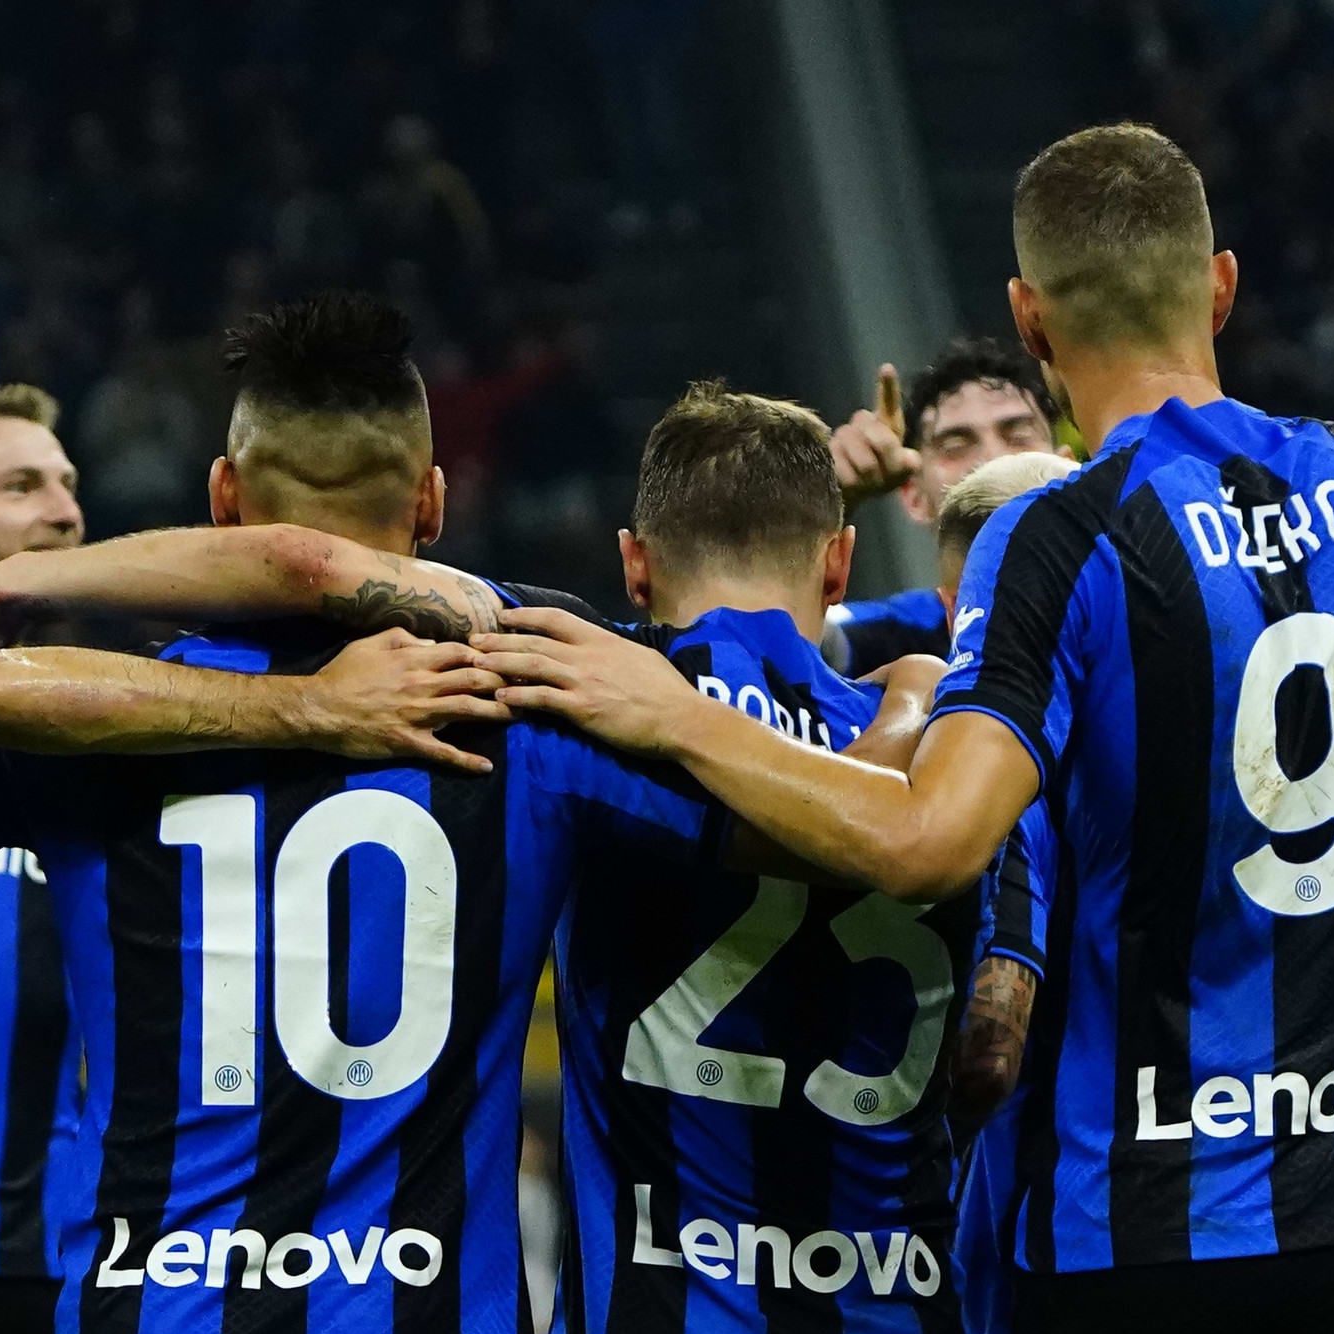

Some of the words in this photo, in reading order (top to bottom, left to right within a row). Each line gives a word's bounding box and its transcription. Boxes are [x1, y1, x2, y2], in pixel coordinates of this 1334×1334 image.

[158, 788, 458, 1106] 10
[621, 873, 956, 1127] 23
[95, 1217, 444, 1290] Lenovo
[631, 1183, 941, 1297] Lenovo
